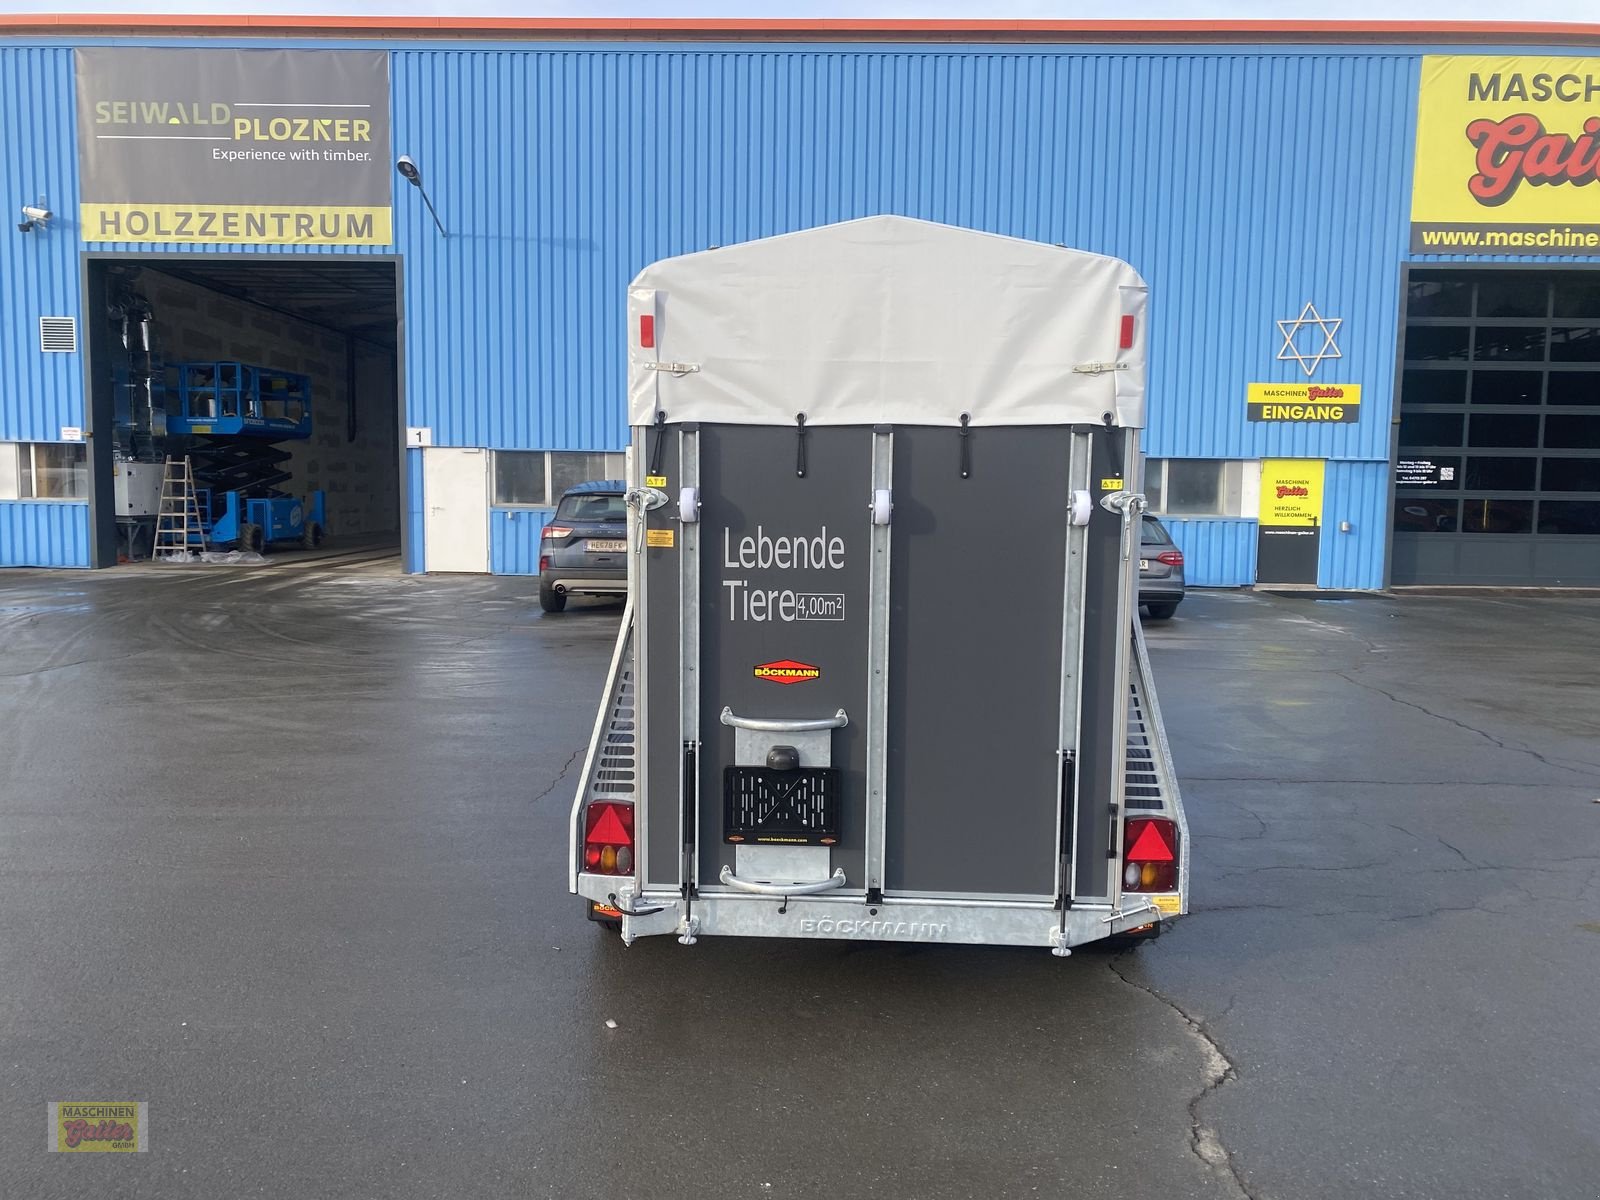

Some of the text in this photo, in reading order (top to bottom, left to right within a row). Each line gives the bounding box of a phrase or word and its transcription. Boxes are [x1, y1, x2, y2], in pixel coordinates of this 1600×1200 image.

[95, 101, 231, 125] SEIWALD
[234, 117, 371, 142] PLOZNER
[212, 148, 372, 163] Experience with timber.
[1466, 113, 1600, 207] Gai
[99, 210, 374, 238] HOLZZENTRUM
[1262, 405, 1344, 420] EINGANG
[416, 431, 422, 443] 1
[724, 525, 845, 569] Lebende
[722, 580, 796, 622] Tiere
[754, 667, 819, 677] BÖCKMANN
[800, 915, 948, 937] BÖCKMANN
